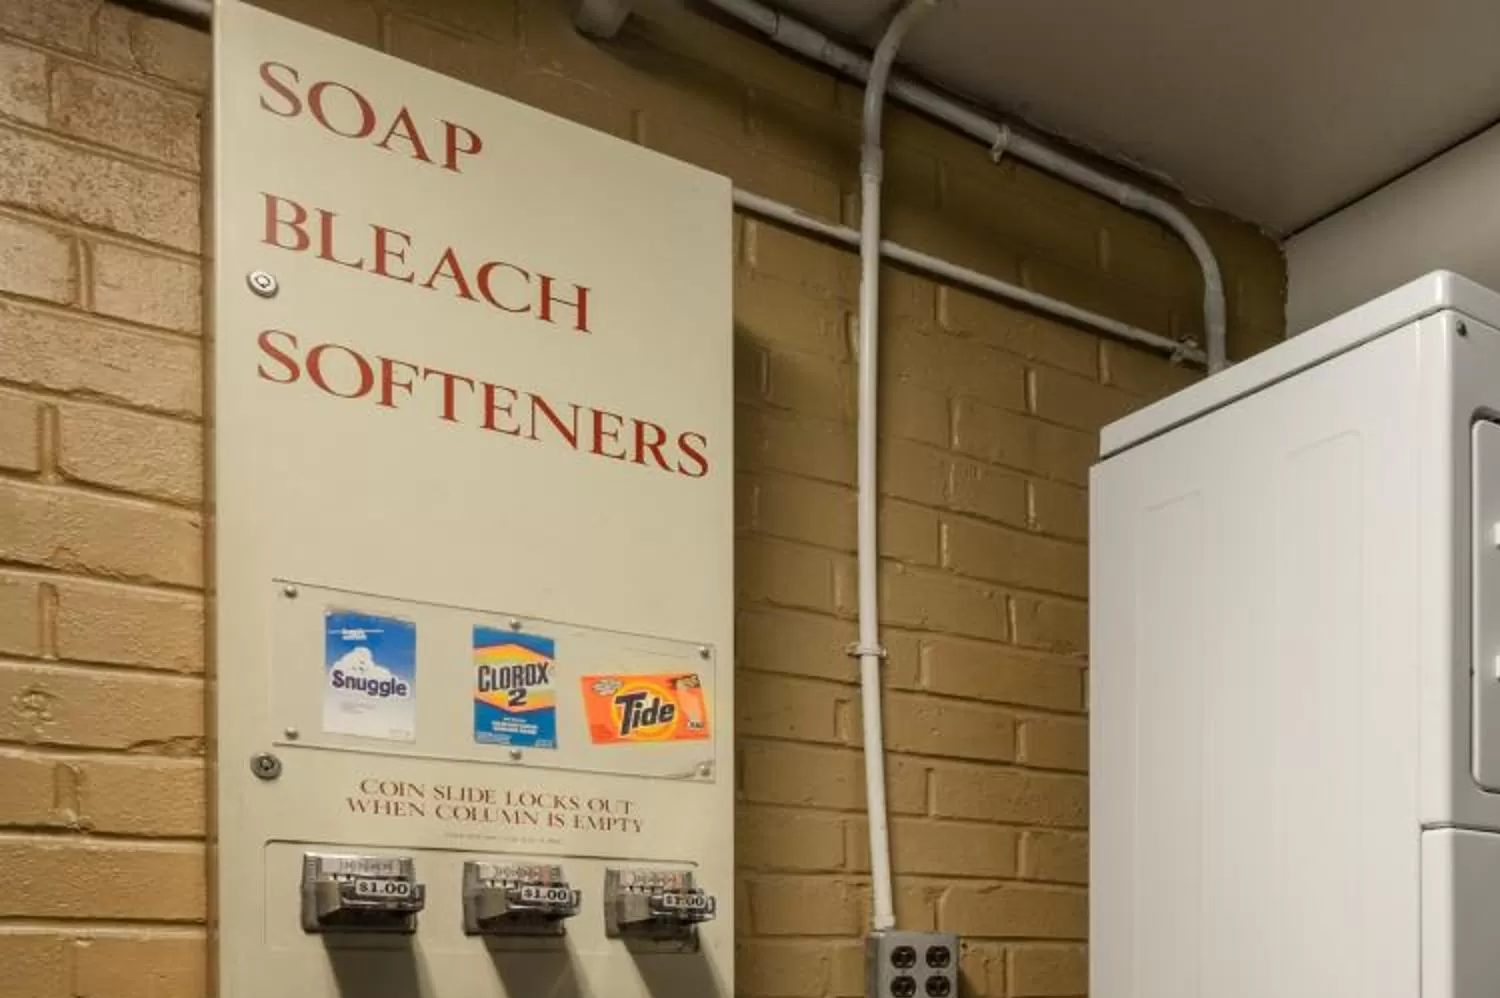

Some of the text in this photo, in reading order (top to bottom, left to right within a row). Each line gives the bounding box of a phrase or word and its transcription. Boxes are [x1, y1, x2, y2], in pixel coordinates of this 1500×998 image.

[259, 61, 483, 174] SOAP
[259, 191, 592, 335] BLEACH
[257, 329, 710, 479] SOFTENERS
[331, 669, 407, 698] Snuggle
[478, 661, 549, 692] CLOROX
[508, 688, 528, 707] 2
[615, 691, 675, 736] Tide
[360, 778, 634, 815] COIN SLIDE LOCKS OUT
[346, 797, 645, 833] WHEN COLUMN IS EMPTY
[359, 881, 409, 895] $1.00
[523, 888, 567, 901] $1.00
[665, 895, 705, 907] $1.00
